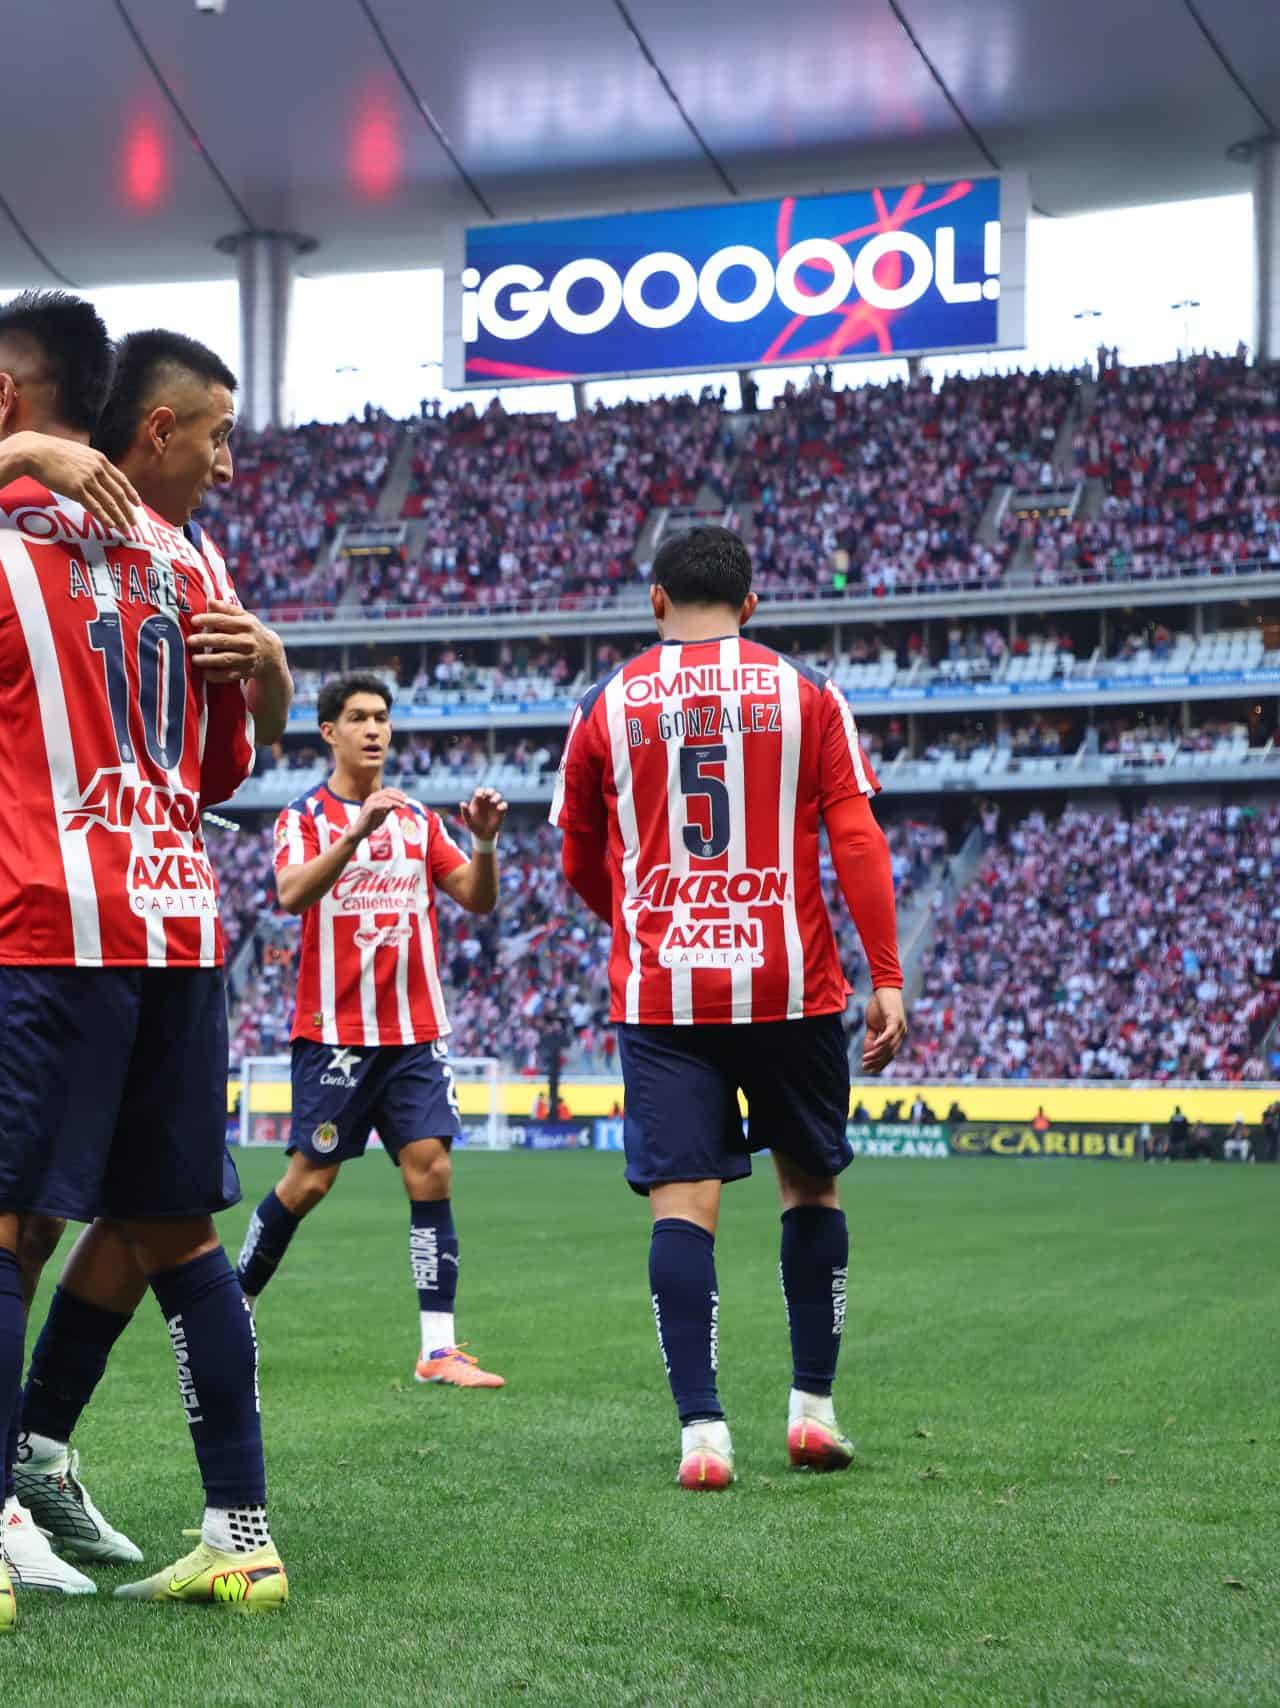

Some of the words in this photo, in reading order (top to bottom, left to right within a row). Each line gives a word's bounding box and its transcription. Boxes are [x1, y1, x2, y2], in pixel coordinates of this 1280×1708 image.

[87, 612, 188, 770] 10
[625, 668, 772, 703] OMNILIFE
[630, 718, 651, 746] B.
[658, 703, 782, 740] GONZALEZ
[62, 772, 199, 832] AKRO
[679, 744, 731, 861] 5
[627, 869, 788, 910] AKRON
[666, 923, 758, 949] AXEN
[663, 952, 762, 964] CAPITAL
[991, 1130, 1137, 1158] CARIBU
[410, 1225, 440, 1291] PERDURA
